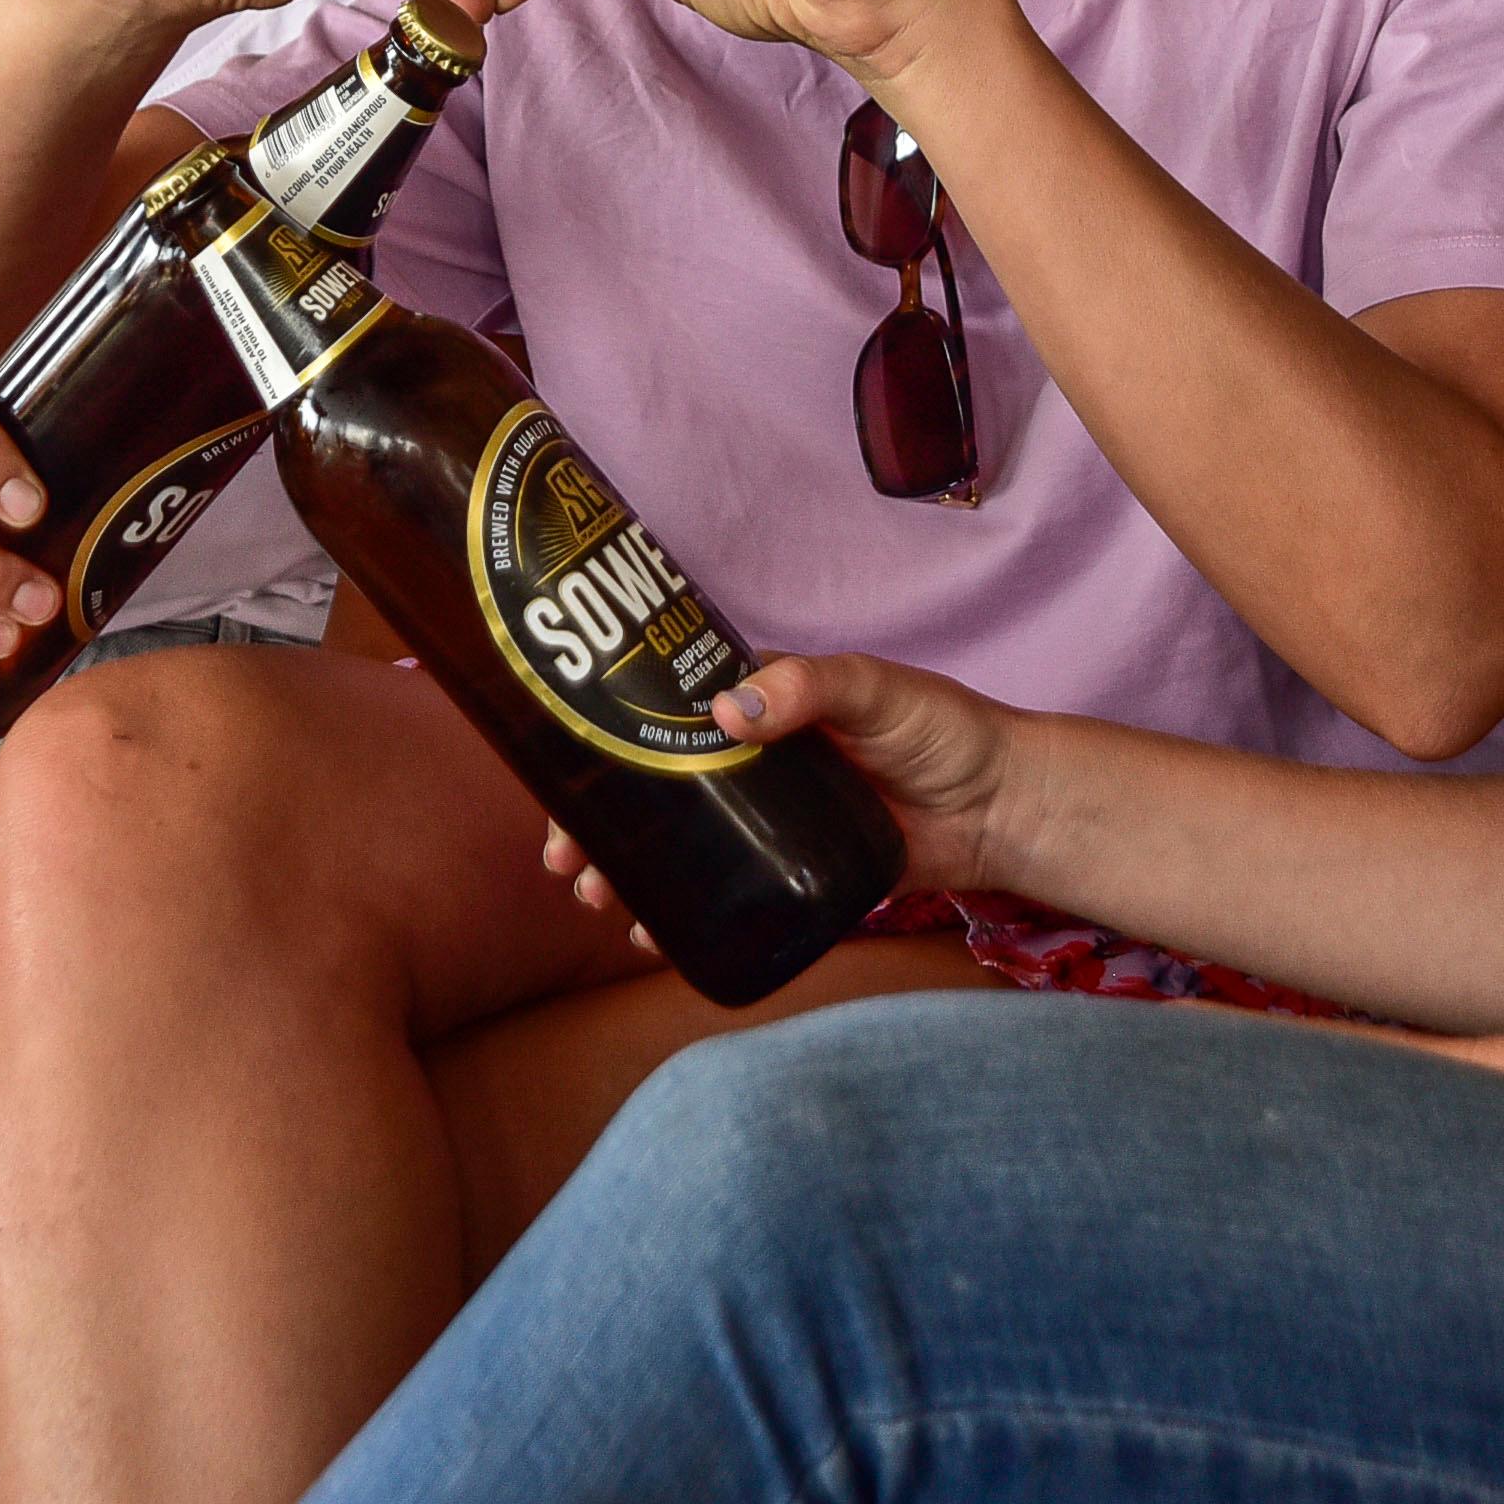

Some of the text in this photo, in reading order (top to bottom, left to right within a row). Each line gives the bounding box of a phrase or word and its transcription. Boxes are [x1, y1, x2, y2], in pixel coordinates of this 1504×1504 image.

[280, 94, 387, 205] ALCOHOL ABUSE IS DANGEROUS
[315, 127, 374, 189] TO YOUR HEALTH
[223, 289, 268, 363] TO YOUR HEALTH
[230, 316, 240, 329] IS
[254, 360, 278, 400] ALCOHOL
[491, 419, 553, 571] BREWED WITH QUALITY
[645, 596, 704, 656] GOLD
[673, 629, 720, 675] SUPERIOR
[679, 662, 713, 692] GOLDEN
[710, 642, 733, 667] LAGER
[639, 723, 672, 745] BORN
[675, 730, 687, 746] IN
